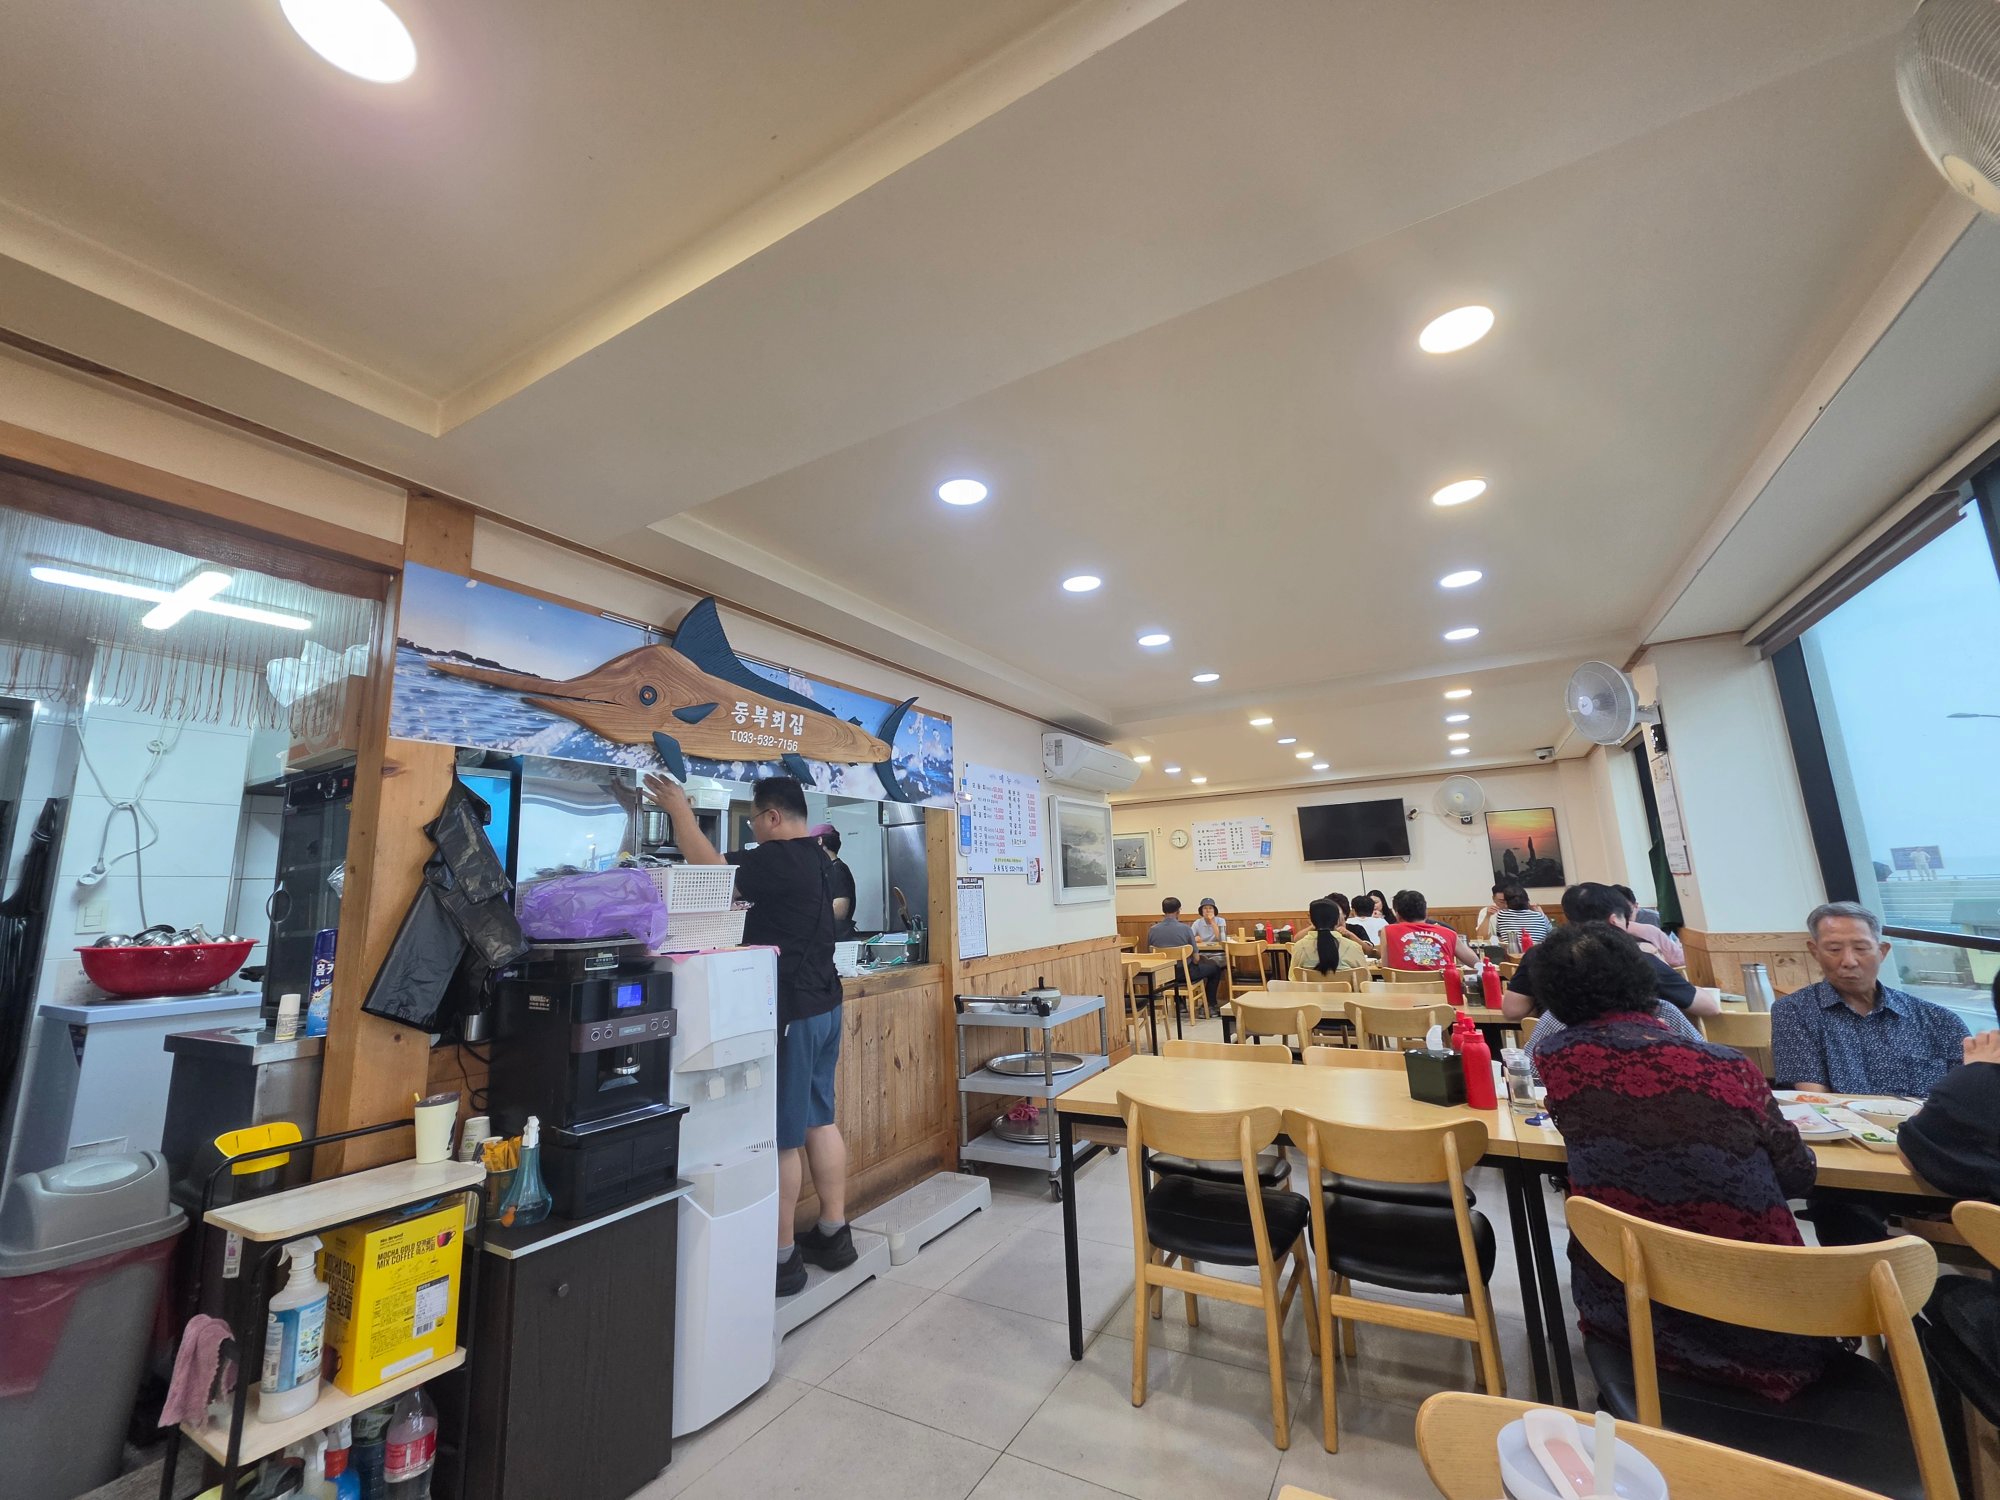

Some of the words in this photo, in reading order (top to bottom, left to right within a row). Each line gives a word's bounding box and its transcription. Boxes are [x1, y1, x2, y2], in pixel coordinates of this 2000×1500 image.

[731, 701, 804, 736] 동북회집
[730, 730, 798, 752] T.033-532-7156
[376, 1259, 390, 1270] MIX
[391, 1250, 415, 1265] COFFEE
[377, 1247, 399, 1261] MOCHA
[400, 1242, 416, 1254] GOLD
